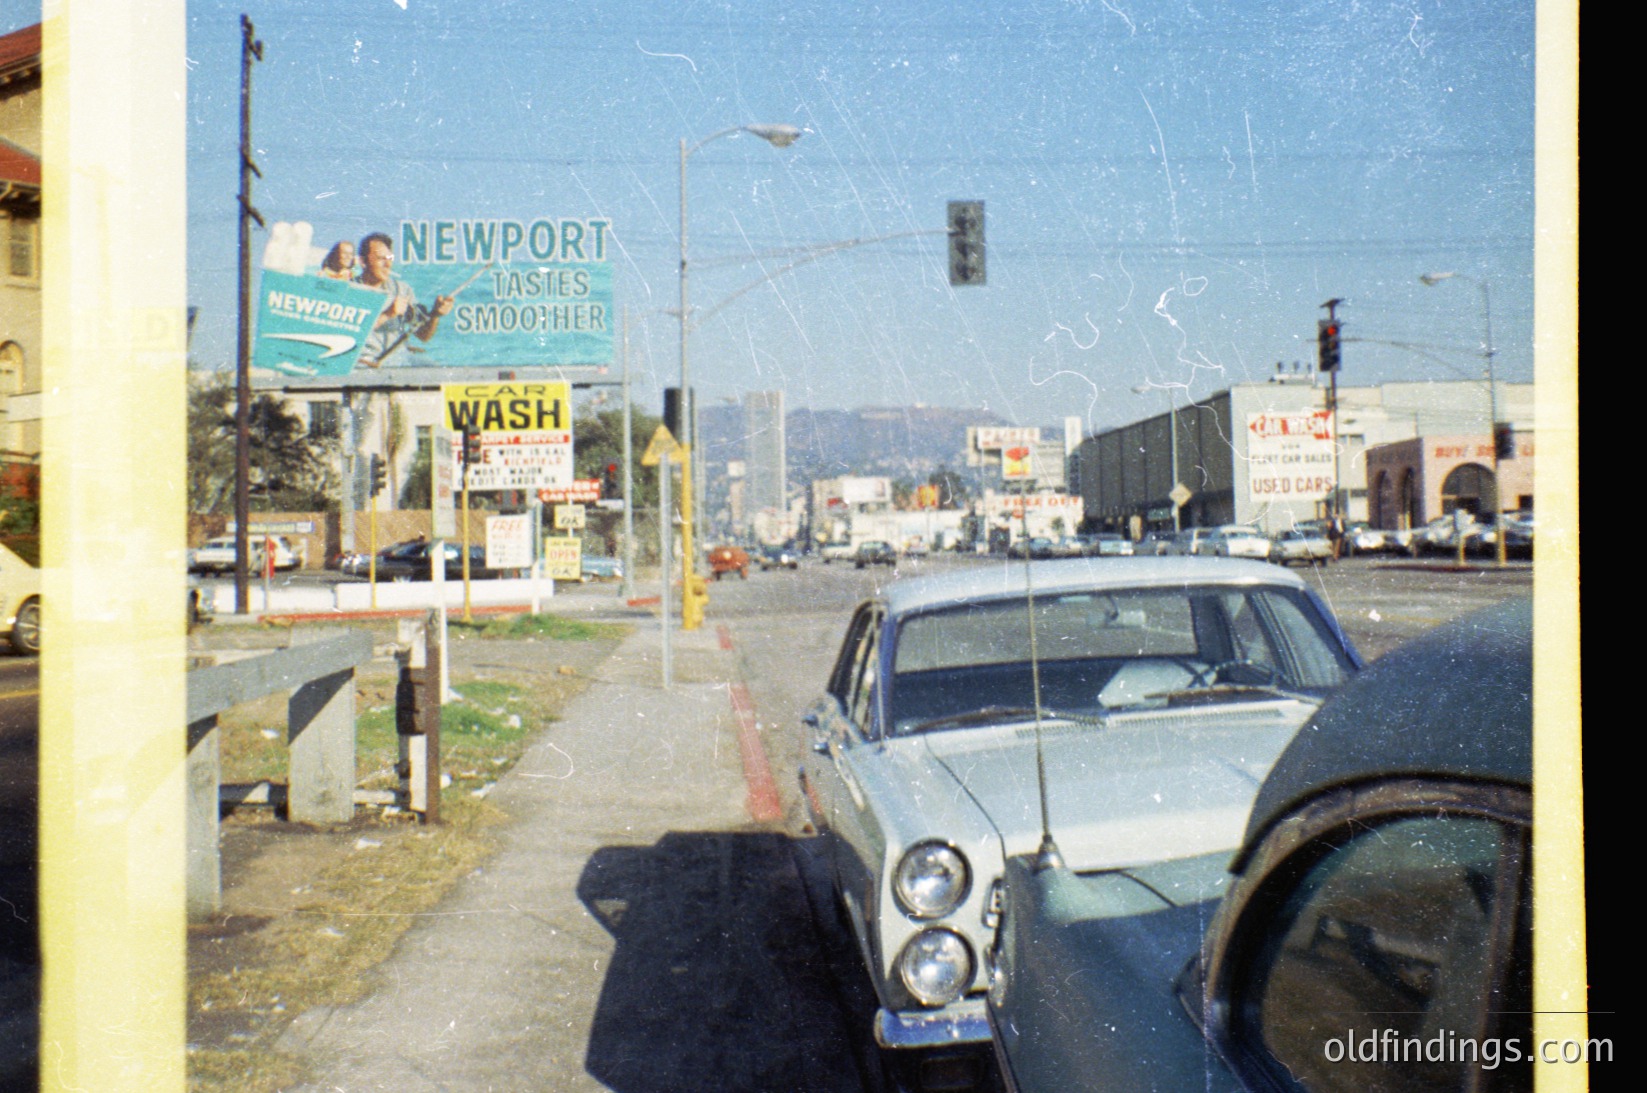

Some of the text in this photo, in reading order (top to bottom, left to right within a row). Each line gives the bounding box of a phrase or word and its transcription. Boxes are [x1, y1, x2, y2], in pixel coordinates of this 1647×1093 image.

[401, 218, 611, 263] NEWPORT
[492, 270, 590, 299] TASTES
[268, 290, 371, 325] NEWPORT
[456, 304, 607, 334] SMOOTHER
[465, 385, 546, 397] CAR
[448, 399, 560, 430] WASH
[1253, 476, 1334, 494] USED CARS
